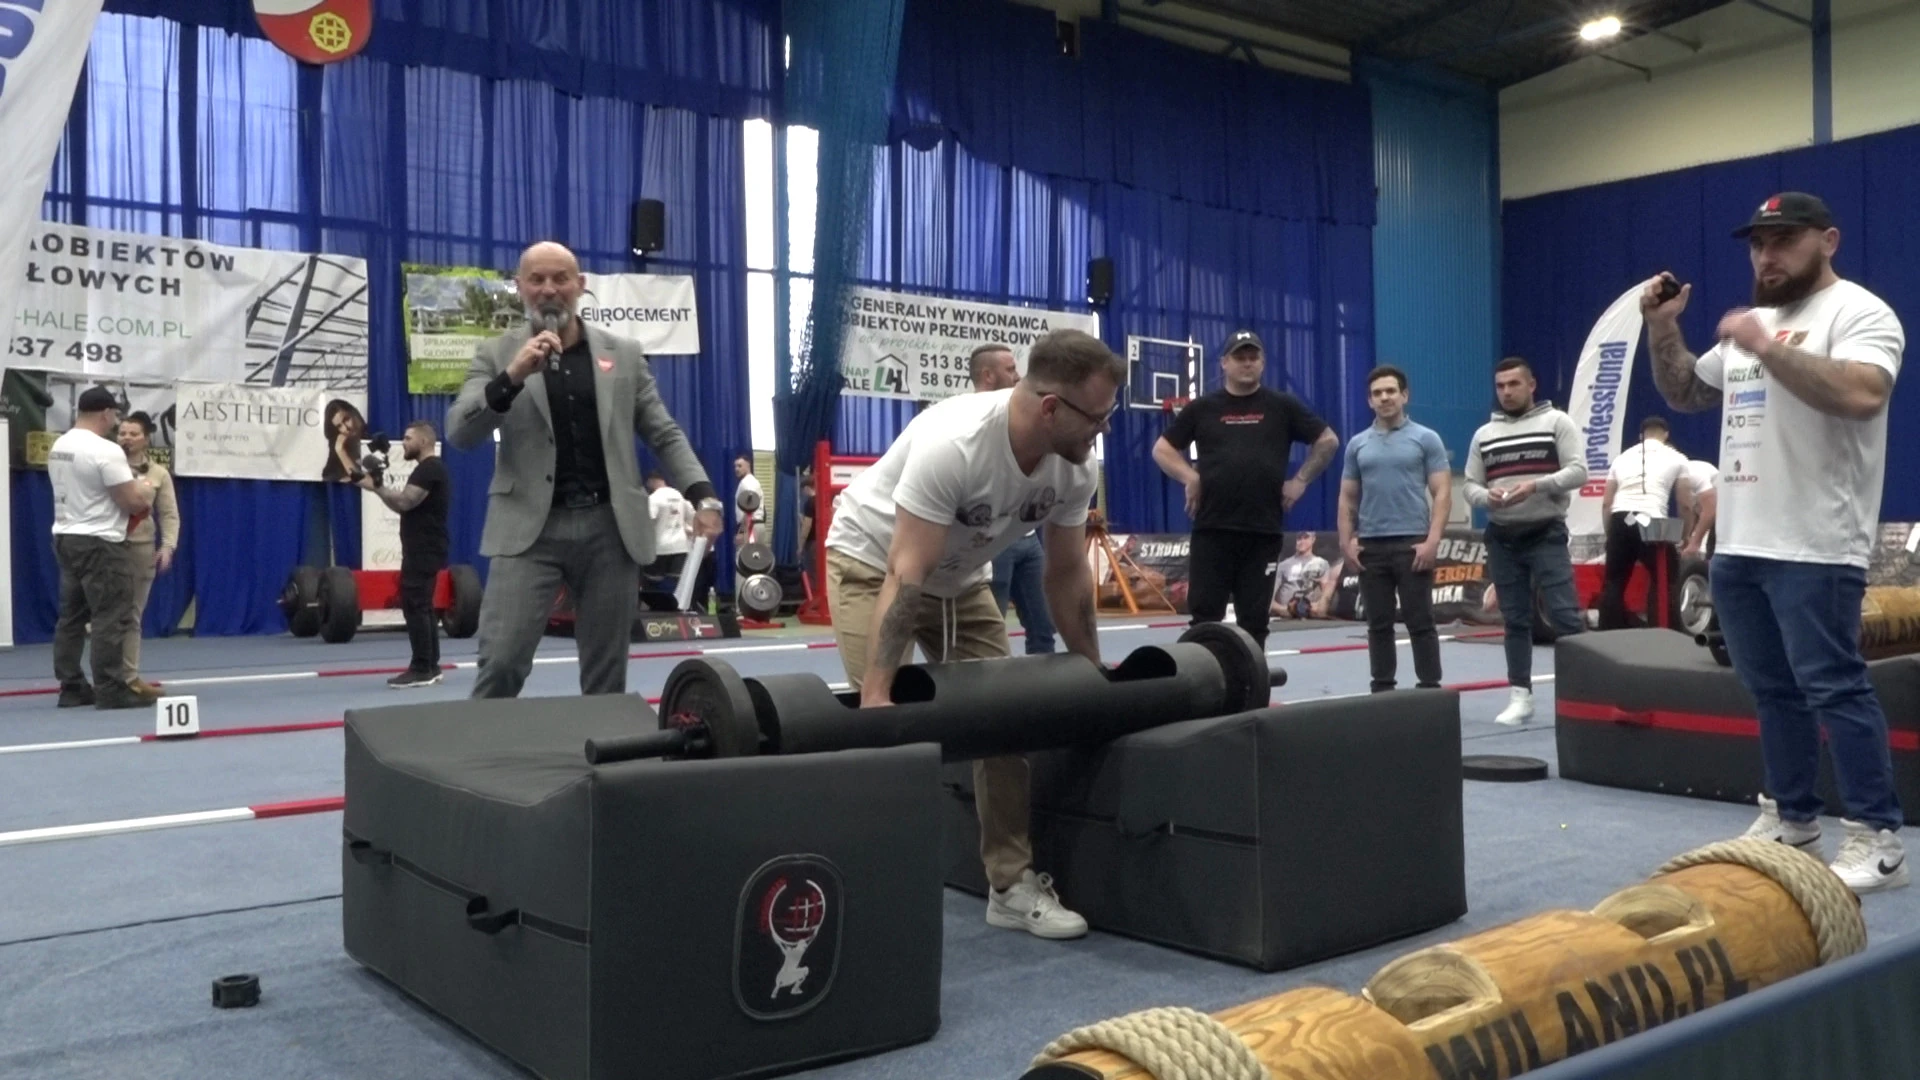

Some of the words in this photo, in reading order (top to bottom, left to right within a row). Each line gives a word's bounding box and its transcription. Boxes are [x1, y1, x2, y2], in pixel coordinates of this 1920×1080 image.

[41, 232, 235, 272] OBIEKTÓW
[580, 306, 692, 322] EUROCEMENT
[851, 296, 947, 321] GENERALNY
[952, 307, 1050, 332] WYKONAWCA
[65, 341, 123, 364] 498
[920, 353, 949, 370] 513
[1131, 344, 1137, 358] 2
[920, 372, 939, 387] 58
[182, 401, 320, 428] AESTHETIC
[1582, 341, 1628, 471] professional
[1140, 541, 1189, 558] STRONG
[165, 702, 190, 728] 10
